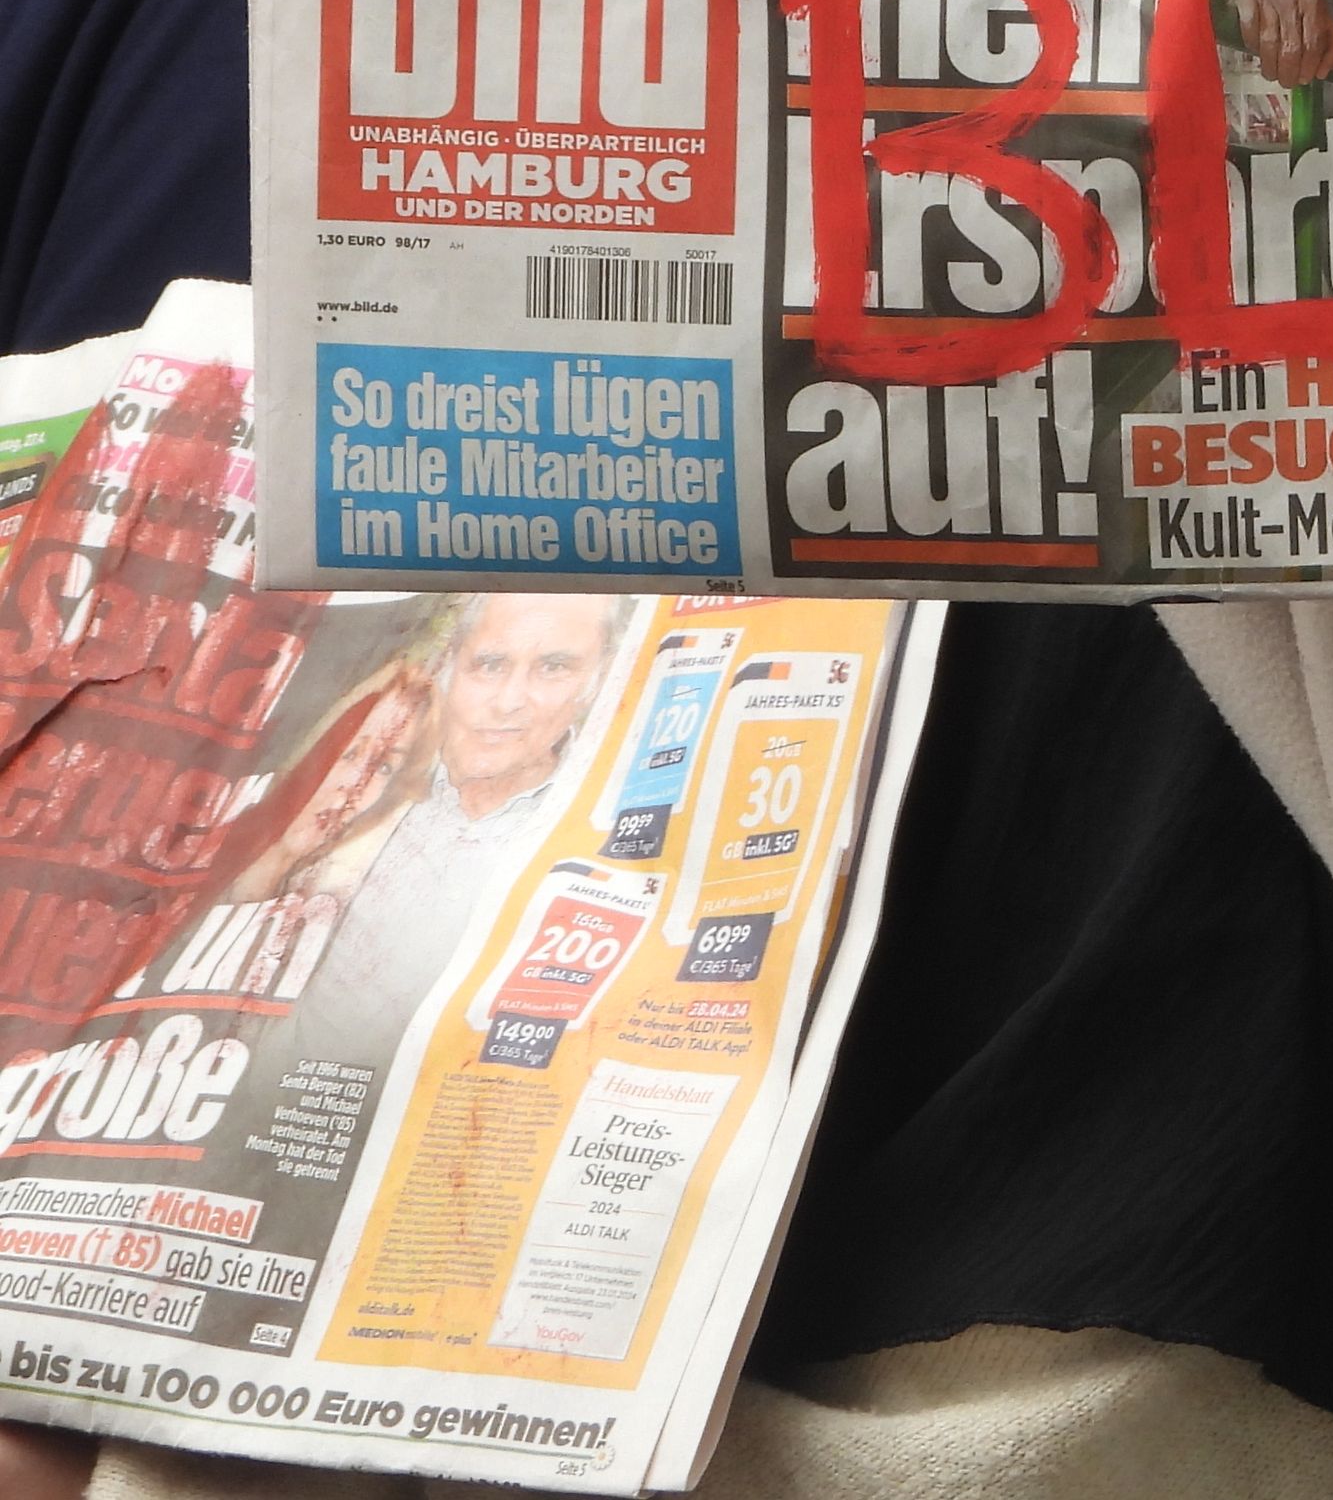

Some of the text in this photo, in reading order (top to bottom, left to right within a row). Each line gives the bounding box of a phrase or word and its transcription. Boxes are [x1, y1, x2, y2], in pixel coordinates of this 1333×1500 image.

[350, 124, 706, 155] UNABHÄNGIG ÜBERPARTEILICH
[361, 147, 692, 202] HAMBURG
[395, 197, 655, 227] UND DER NORDEN
[317, 233, 344, 247] 1,30
[348, 235, 386, 248] EURO
[395, 236, 431, 250] 98/17
[685, 249, 717, 260] 50017
[317, 301, 399, 315] www.bild.de
[1192, 350, 1266, 413] Ein
[332, 359, 720, 447] So dreist lügen
[785, 352, 1100, 537] auf!
[331, 432, 725, 504] faule Mitarbeiter
[340, 499, 719, 565] im Home Office
[706, 579, 745, 592] Seite 5
[743, 694, 825, 710] JAHRES-PAKET
[649, 701, 700, 749] 120
[739, 764, 802, 828] 30
[617, 813, 654, 838] 99.99
[743, 836, 772, 858] inkl.
[161, 893, 340, 999] um
[525, 925, 621, 971] 200
[698, 925, 752, 954] 69.99
[689, 960, 727, 975] €/365
[495, 1019, 555, 1047] 149.00
[684, 1017, 718, 1033] ALDI
[618, 1030, 753, 1057] oder ALDI TALK App!
[0, 1013, 250, 1153] große
[296, 1060, 316, 1075] Seit
[340, 1067, 374, 1082] waren
[279, 1074, 367, 1100] Senta Berger (82)
[603, 1074, 715, 1105] Handelsblatt
[274, 1105, 329, 1128] Verhoeven
[300, 1094, 363, 1115] und Michael
[270, 1125, 351, 1149] verheiratet. Am
[603, 1113, 672, 1141] Preis-
[245, 1134, 347, 1165] Montag hat der Tod
[568, 1135, 686, 1172] Leistungs-
[276, 1158, 340, 1182] sie getrennt
[579, 1162, 654, 1195] Sieger
[11, 1181, 258, 1240] Filmemacher Michael
[588, 1200, 622, 1216] 2024
[564, 1222, 631, 1242] ALDI TALK
[112, 1229, 164, 1272] 85)
[165, 1246, 214, 1282] gab
[217, 1253, 253, 1289] sie
[256, 1257, 306, 1298] ihre
[153, 1294, 200, 1329] auf
[253, 1326, 276, 1343] Seite
[535, 1323, 586, 1344] YouGov
[9, 1340, 618, 1449] bis zu 100 000 Euro gewinnen!
